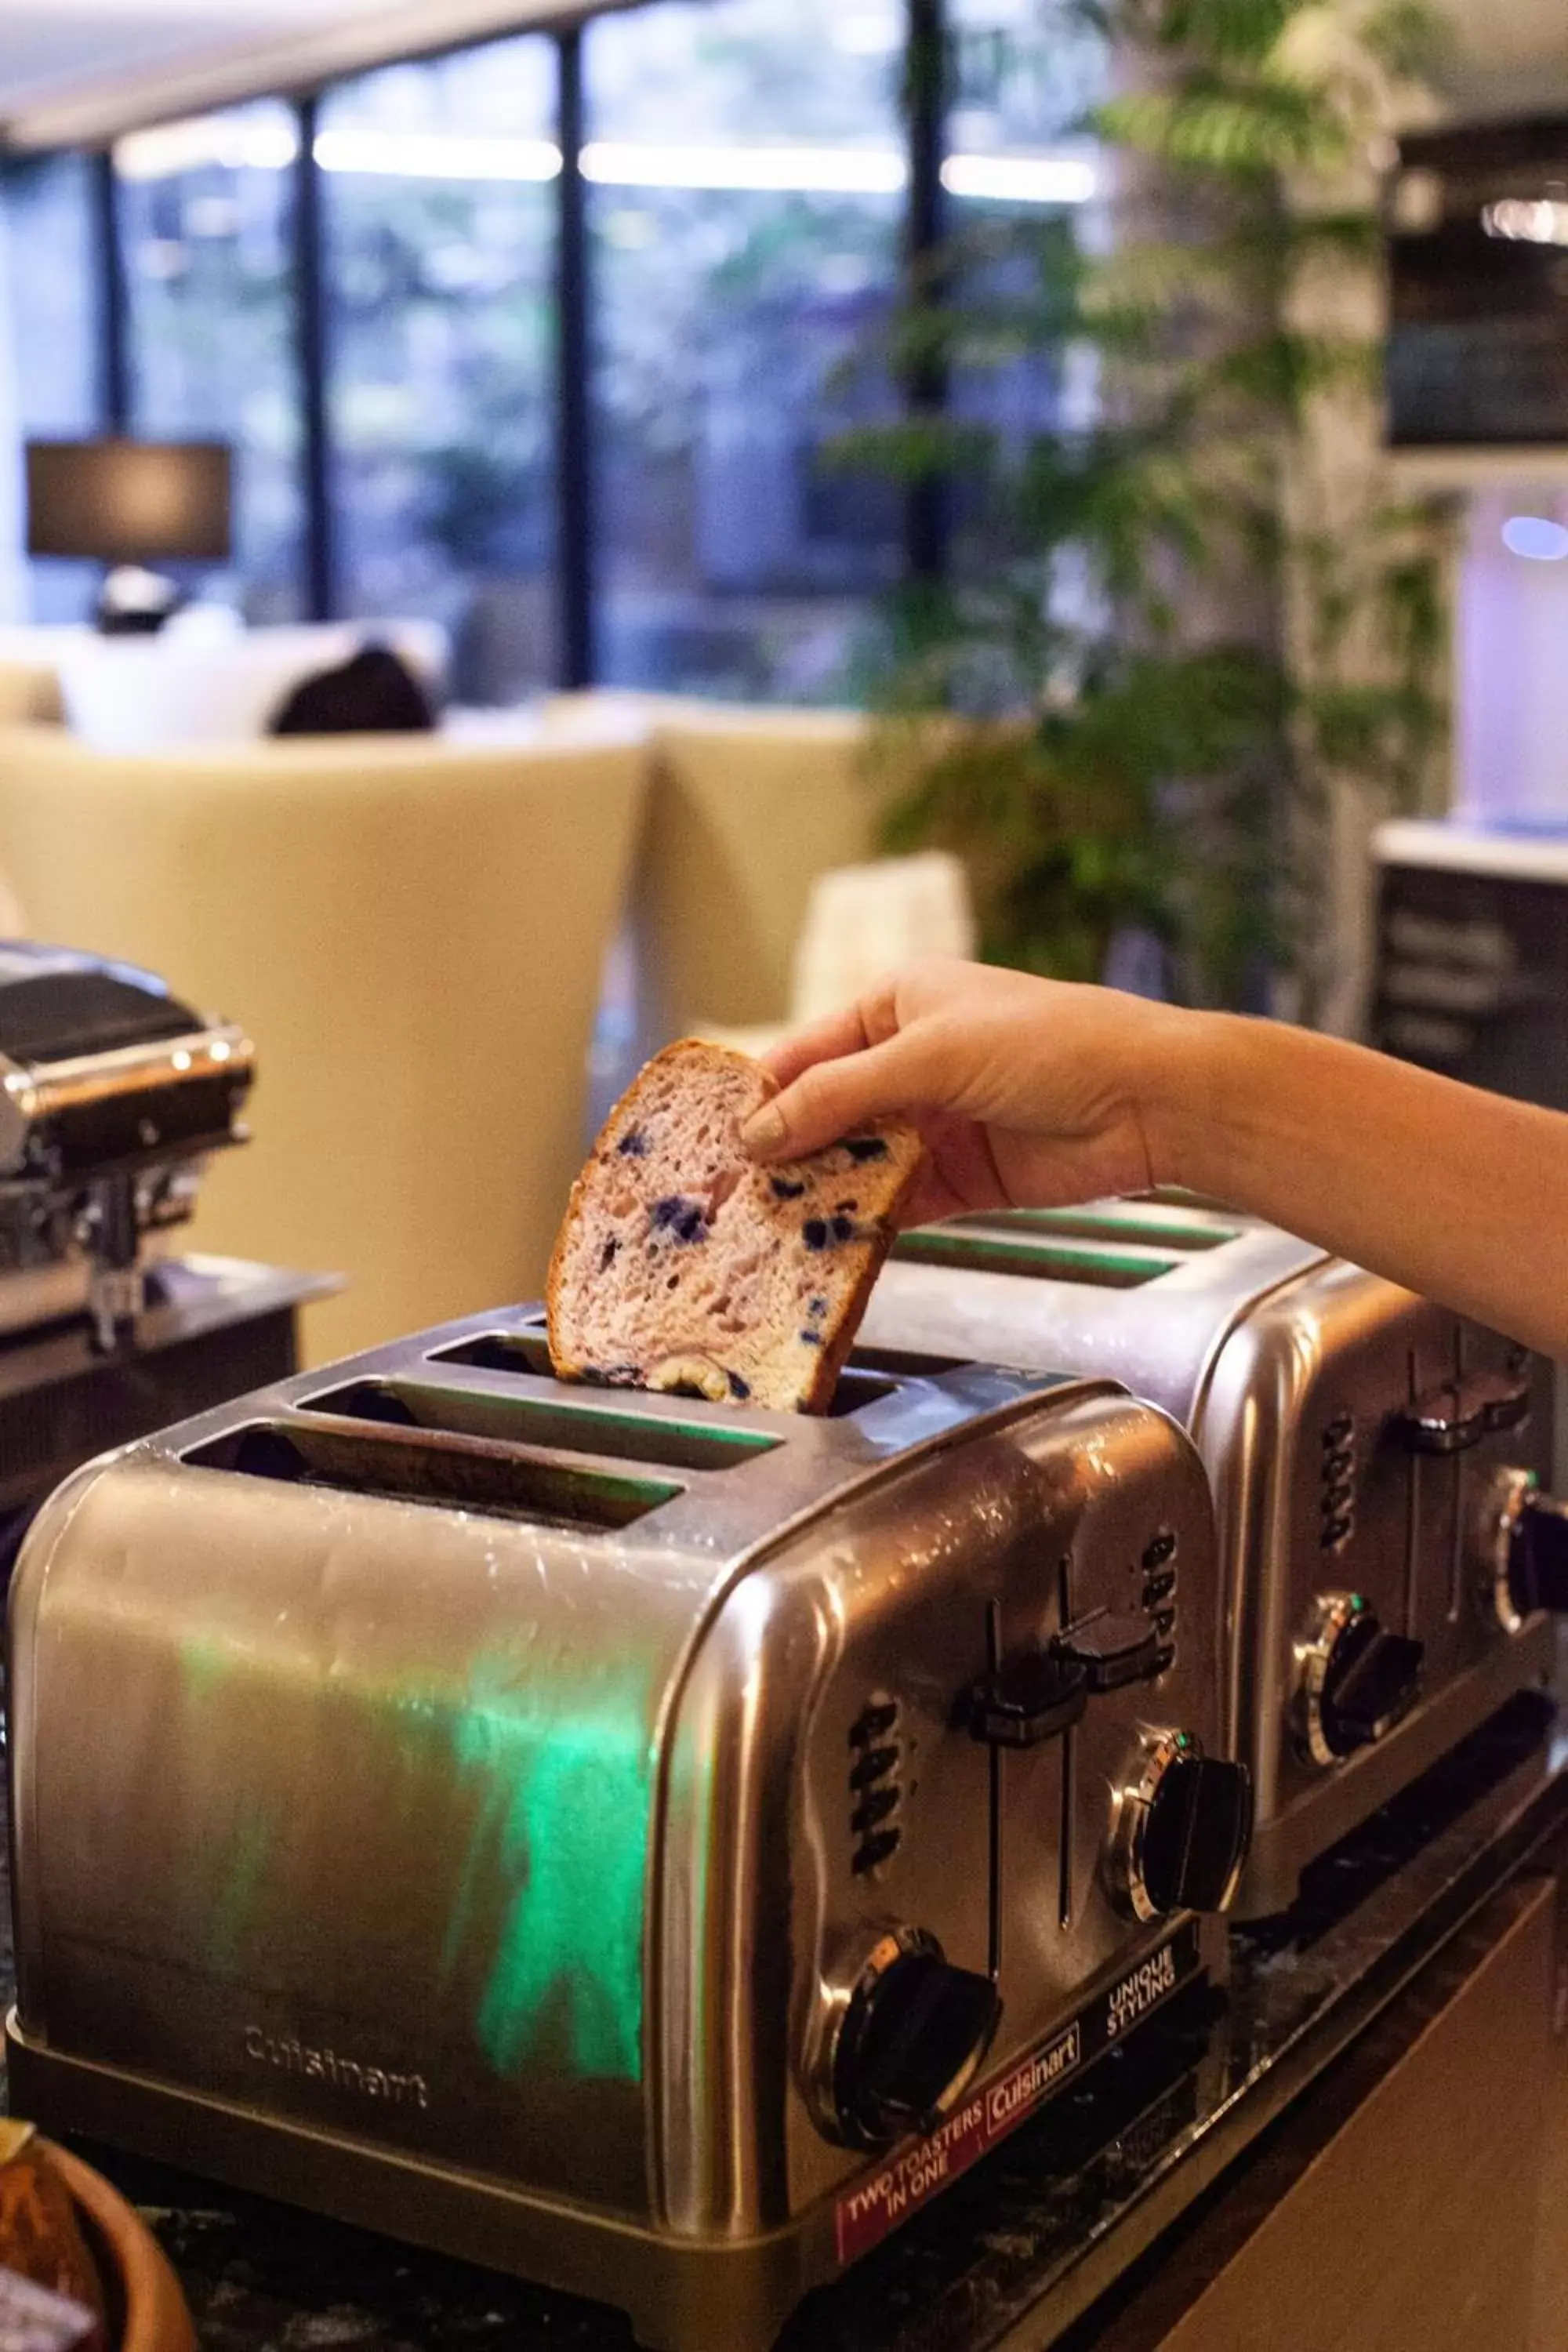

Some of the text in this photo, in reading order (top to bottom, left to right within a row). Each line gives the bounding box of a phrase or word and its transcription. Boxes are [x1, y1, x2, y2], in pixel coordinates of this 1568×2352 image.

[1107, 1963, 1174, 2036] STYLING
[1109, 1944, 1173, 2010] UNIQUE
[992, 2034, 1075, 2119] Cuisinart
[848, 2100, 983, 2221] TWO TOASTERS
[887, 2151, 949, 2218] IN ONE
